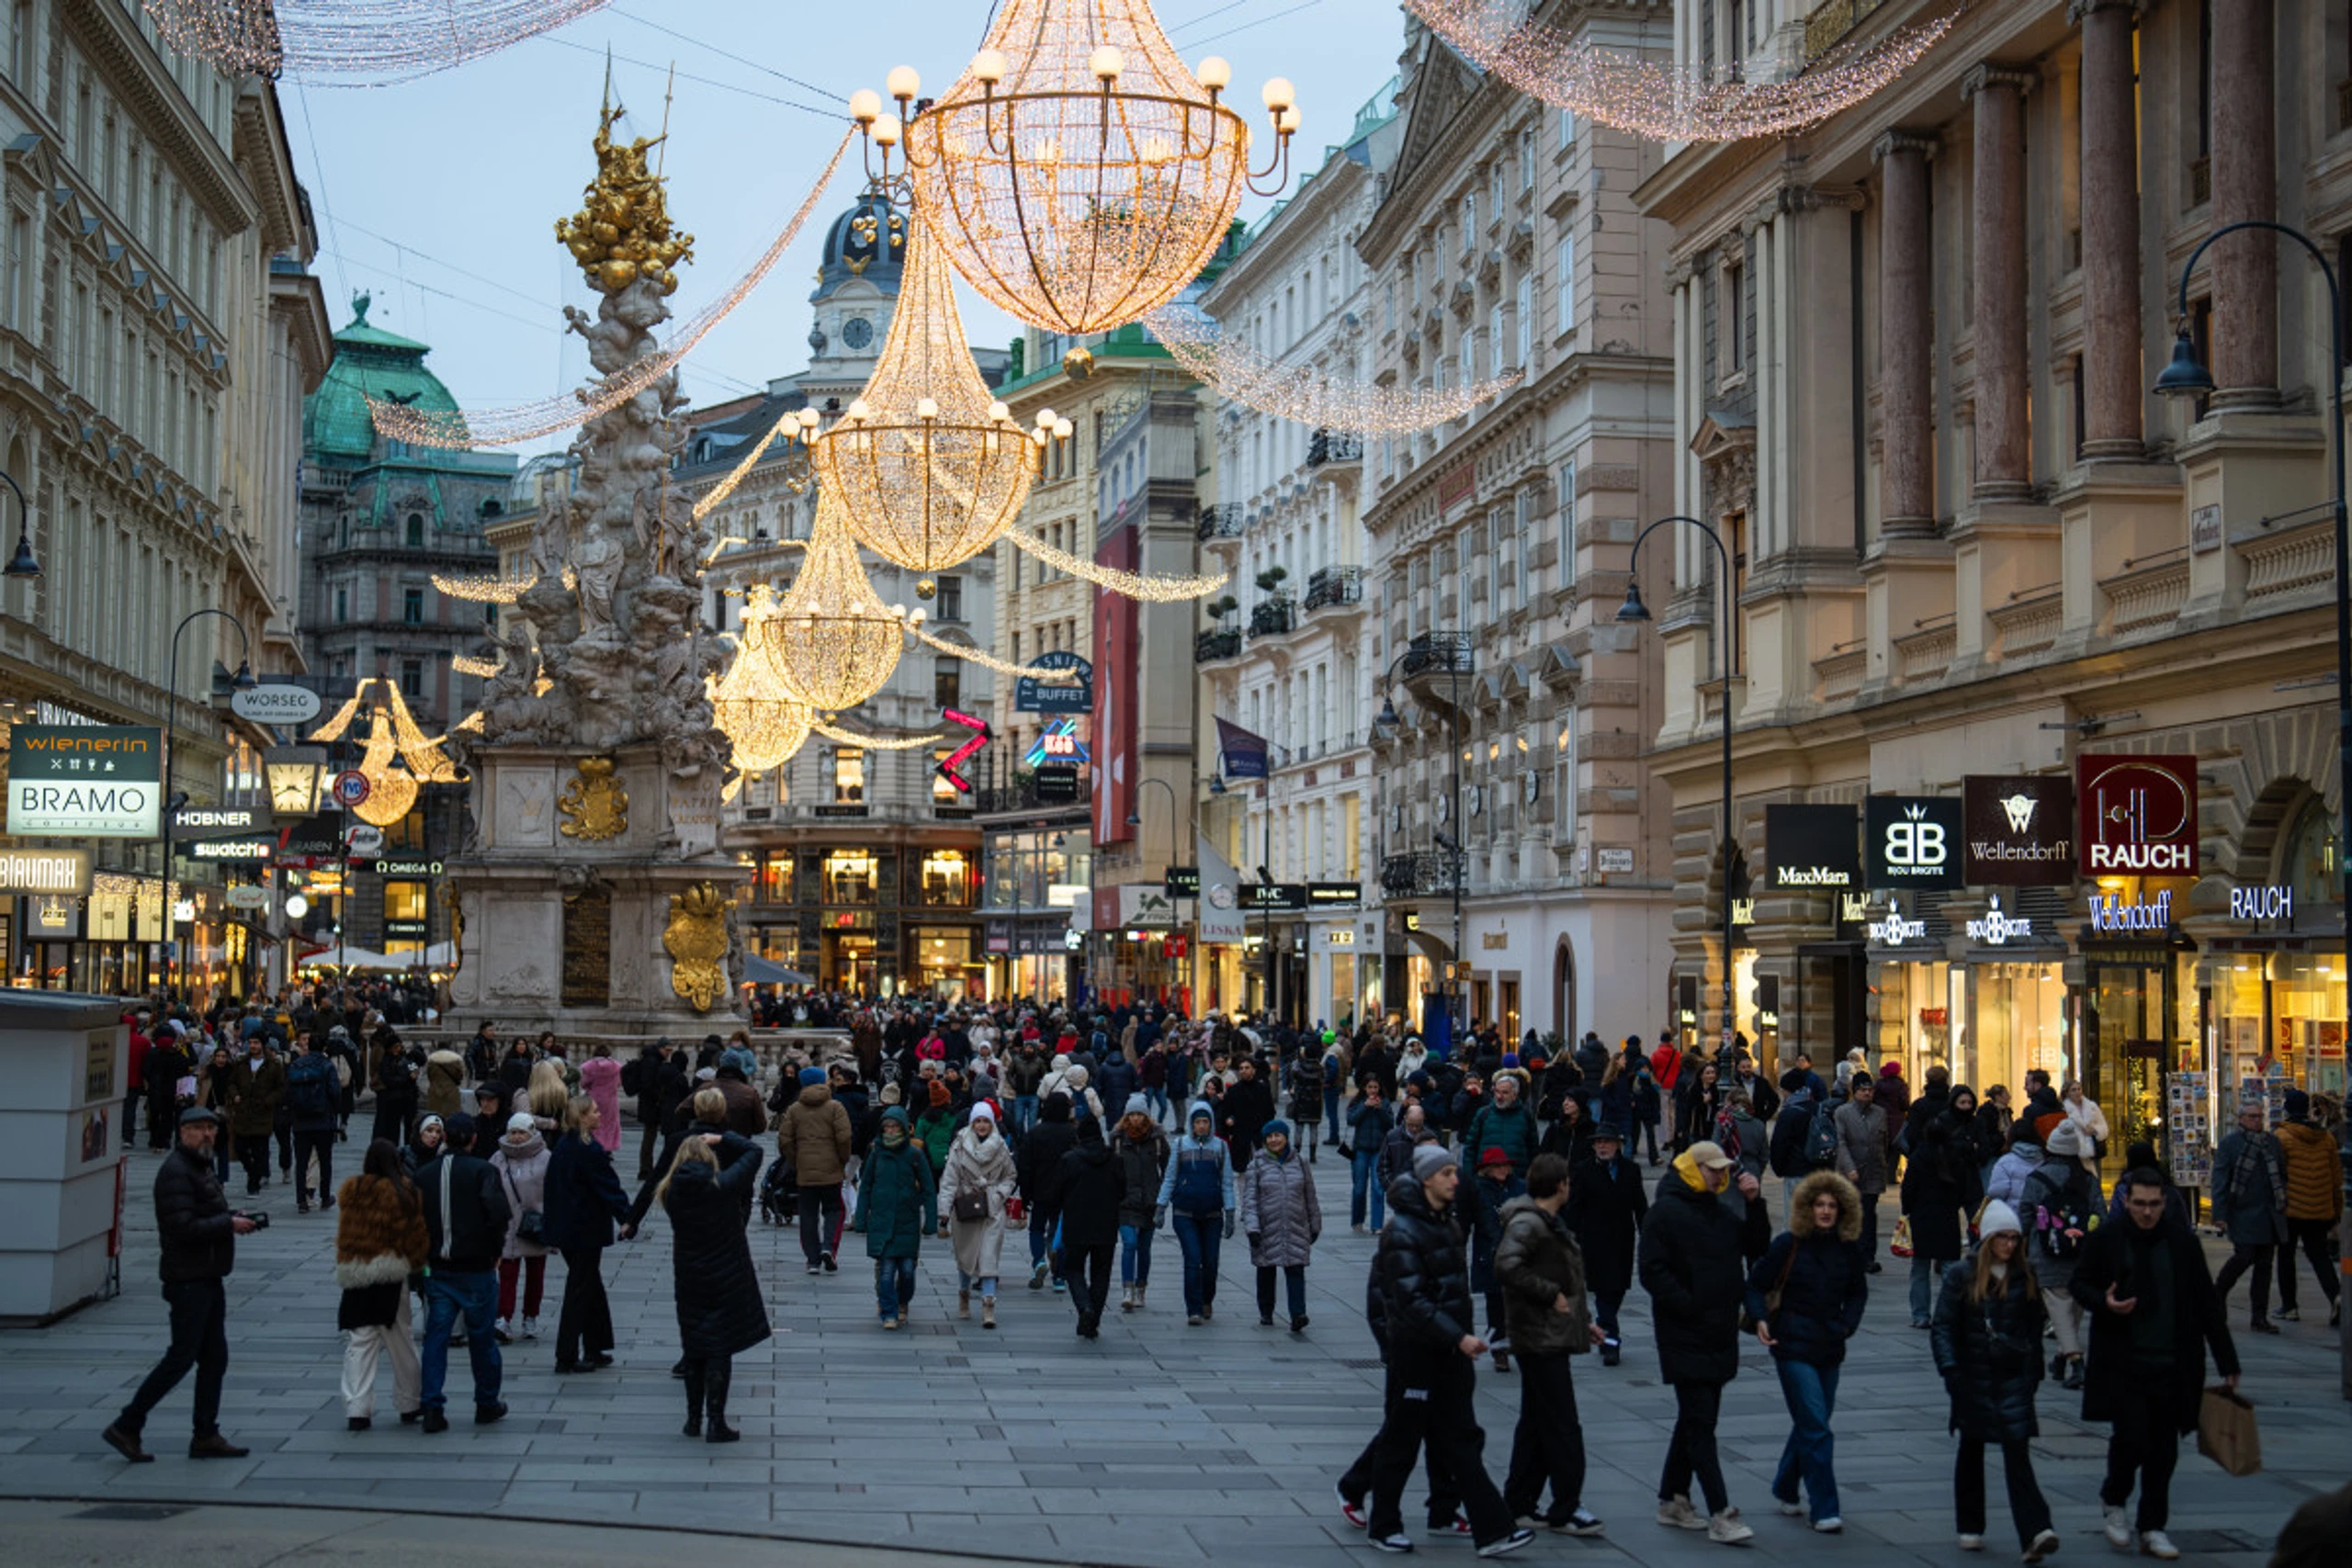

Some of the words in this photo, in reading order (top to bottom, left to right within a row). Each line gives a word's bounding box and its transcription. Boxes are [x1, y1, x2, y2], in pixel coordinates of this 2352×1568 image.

[244, 694, 308, 706] WORSEG
[1036, 688, 1084, 701] BUFFET
[25, 736, 147, 751] wienerin
[22, 787, 144, 813] BRAMO
[195, 842, 257, 857] swatch
[1971, 840, 2069, 861] Wellendorff
[2091, 844, 2190, 868] RAUCH
[390, 863, 426, 874] OMEGA
[1778, 866, 1849, 885] MaxMara
[1887, 866, 1909, 876] BIJOU
[1912, 866, 1944, 875] BRIGITTE
[1257, 887, 1283, 899] IWC
[2088, 889, 2173, 931] Wellendorff
[2231, 886, 2292, 919] RAUCH
[1203, 922, 1243, 936] LISKA
